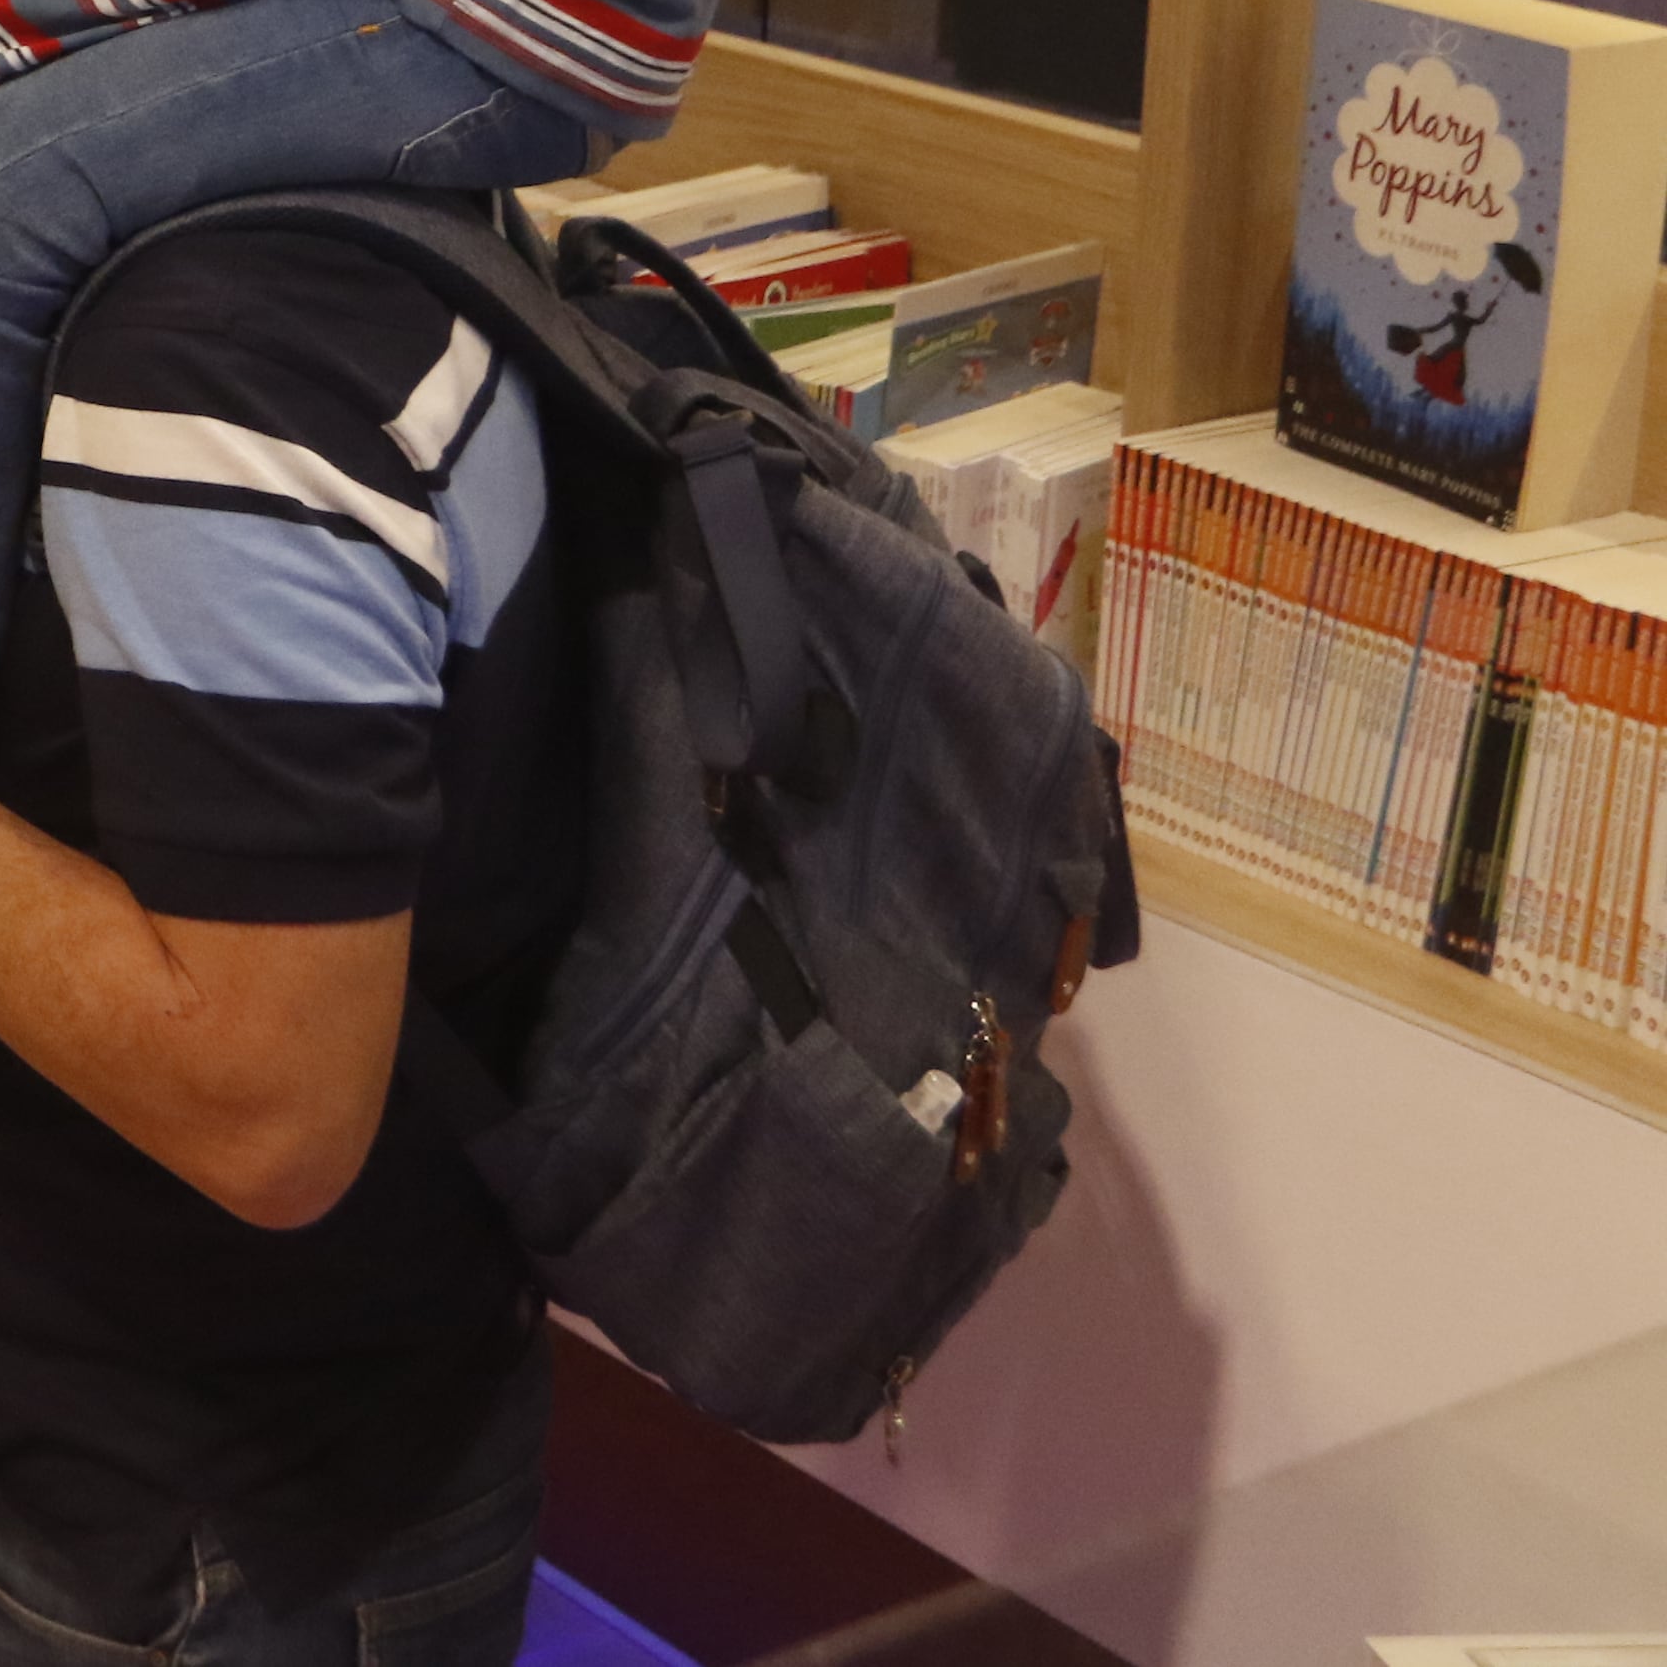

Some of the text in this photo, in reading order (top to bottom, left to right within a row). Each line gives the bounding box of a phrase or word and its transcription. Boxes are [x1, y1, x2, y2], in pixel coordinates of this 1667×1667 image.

[1371, 85, 1486, 174] Mary
[1349, 133, 1504, 224] Poppins
[1292, 421, 1503, 509] THE COMPLETE MARY POPPINS
